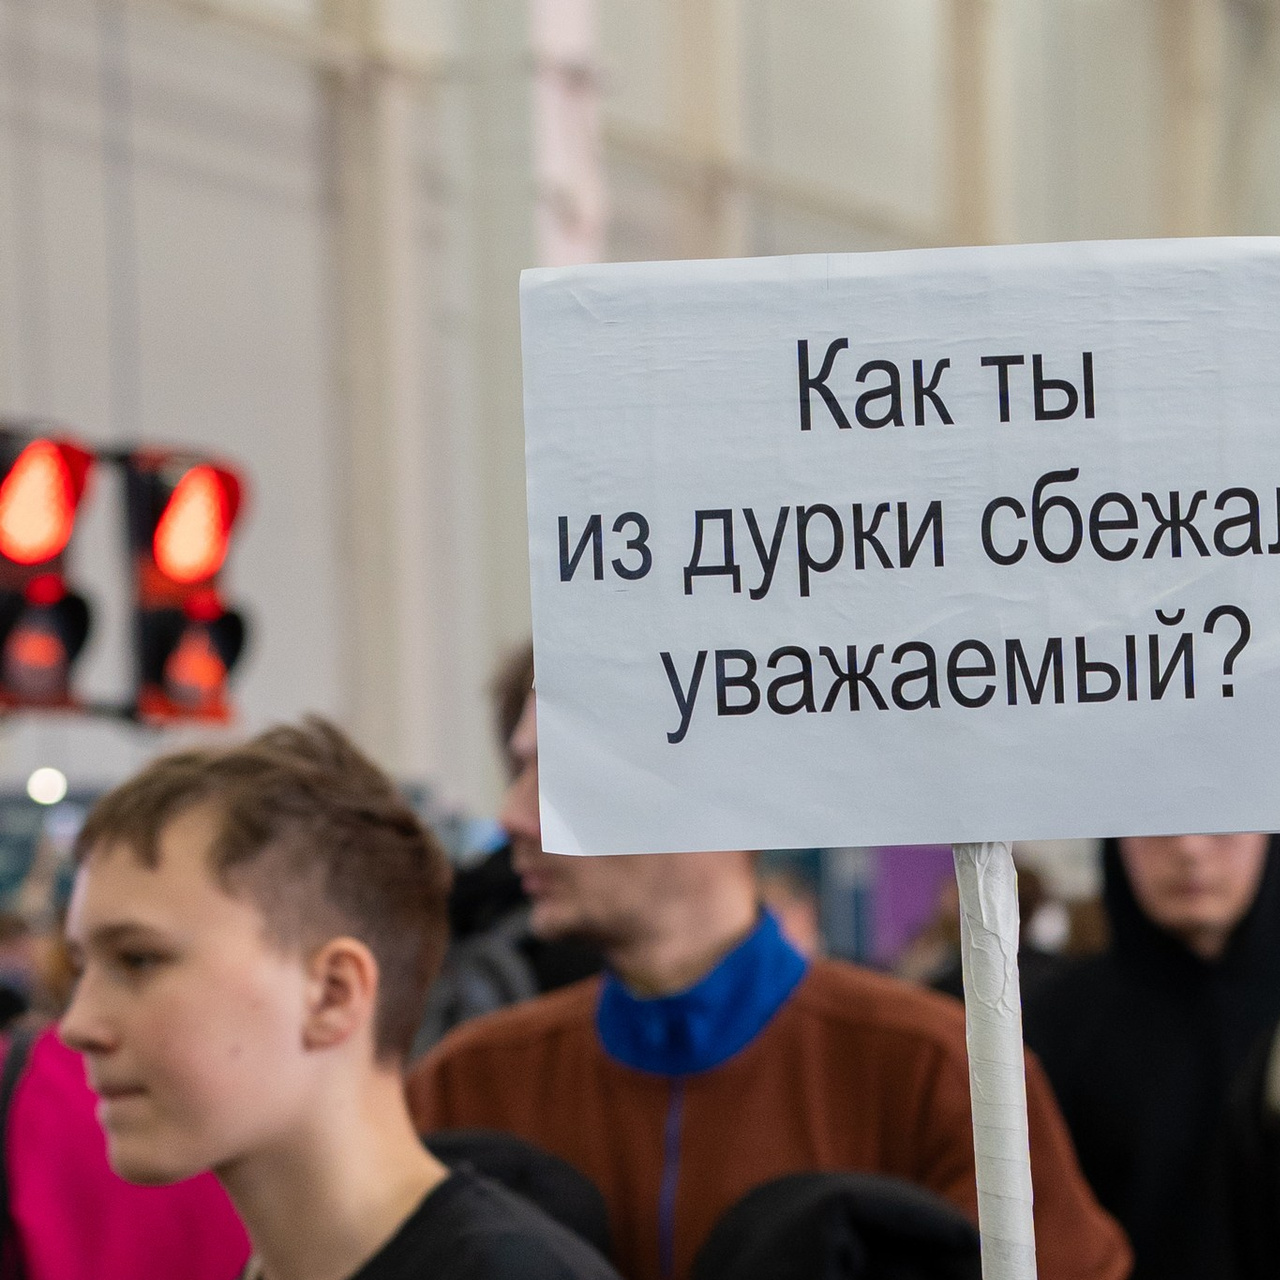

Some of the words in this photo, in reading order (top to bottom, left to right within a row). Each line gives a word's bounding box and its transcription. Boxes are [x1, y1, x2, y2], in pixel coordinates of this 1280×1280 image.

[797, 337, 955, 431] Как
[980, 351, 1096, 423] ты
[557, 511, 653, 582] из
[683, 500, 945, 601] дурки
[659, 604, 1252, 745] уважаемый?
